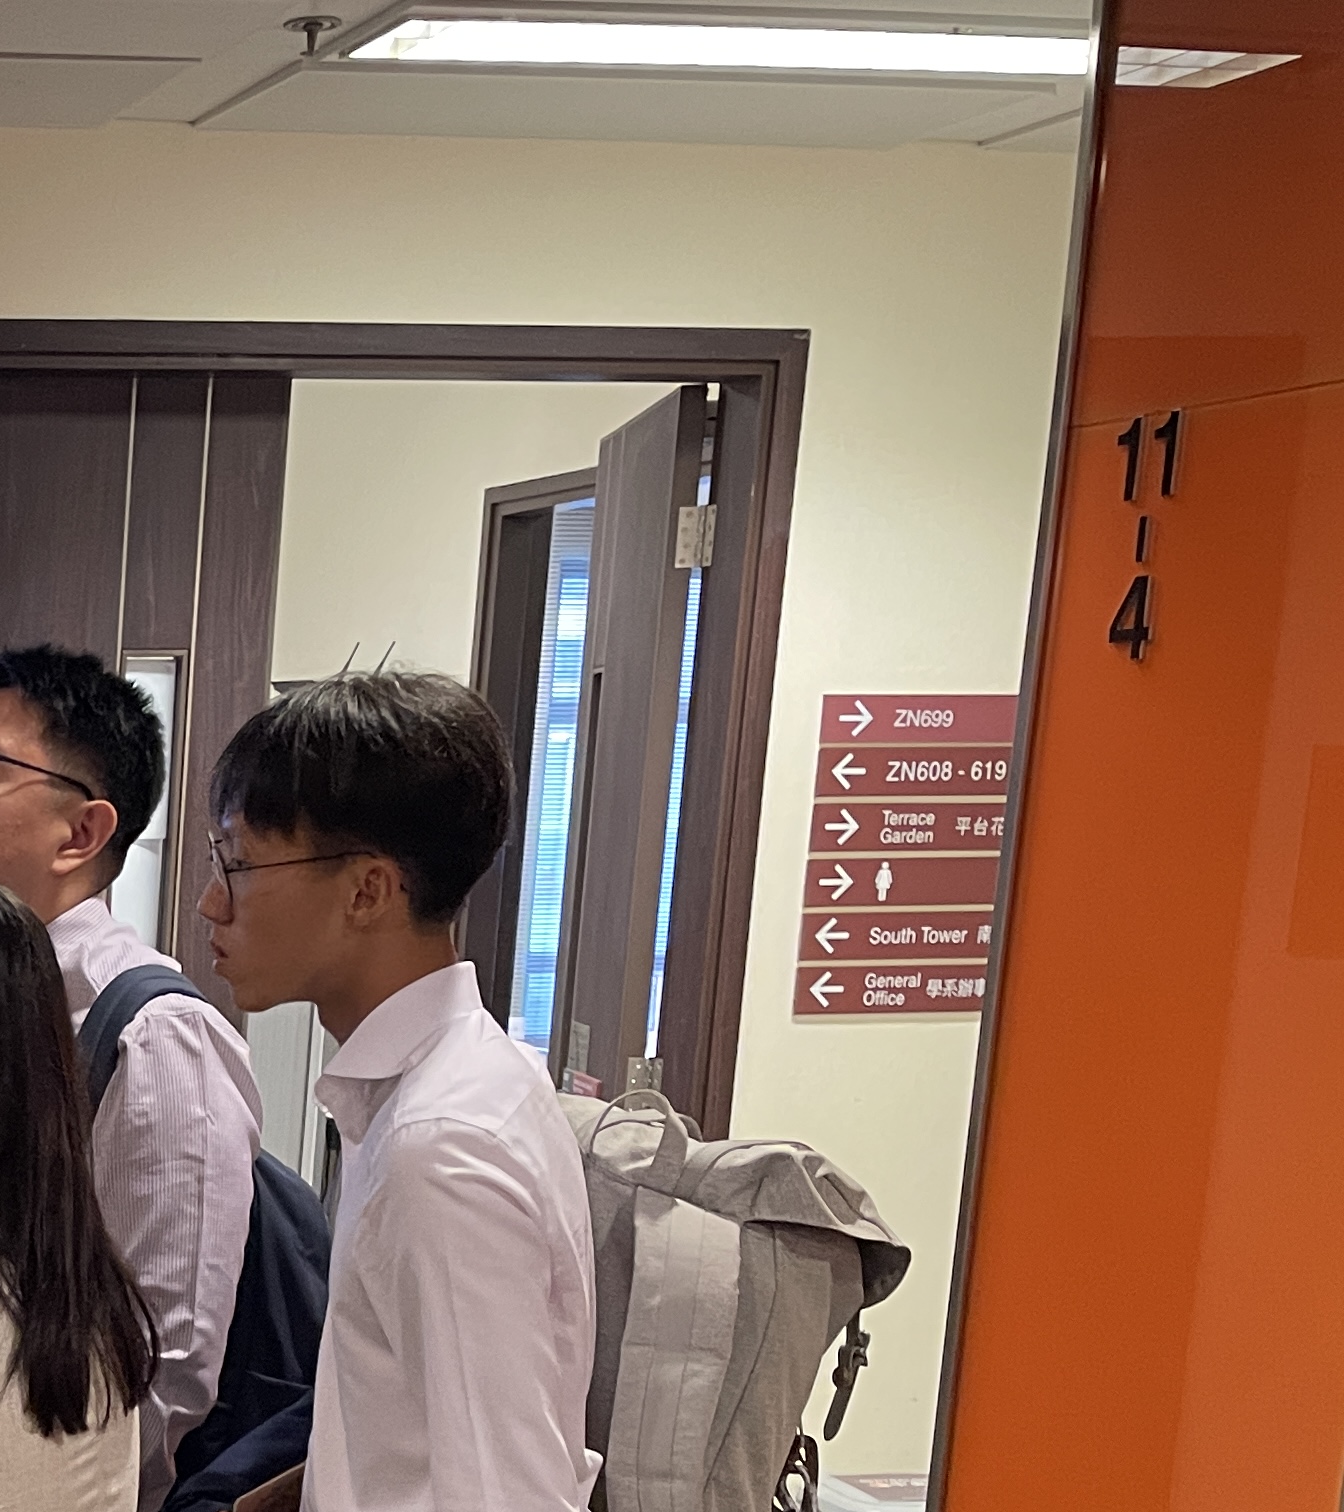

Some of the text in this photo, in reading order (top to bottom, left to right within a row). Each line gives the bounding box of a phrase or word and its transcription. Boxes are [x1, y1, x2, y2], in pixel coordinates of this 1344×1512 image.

[1117, 408, 1181, 501] 11
[1109, 574, 1151, 660] 4
[893, 708, 954, 728] ZN699
[885, 761, 952, 782] ZN608
[970, 760, 1007, 781] 619
[882, 809, 935, 826] Terrace
[879, 827, 934, 844] Garden
[868, 925, 968, 946] South Tower
[864, 971, 922, 989] General
[862, 990, 905, 1007] Office
